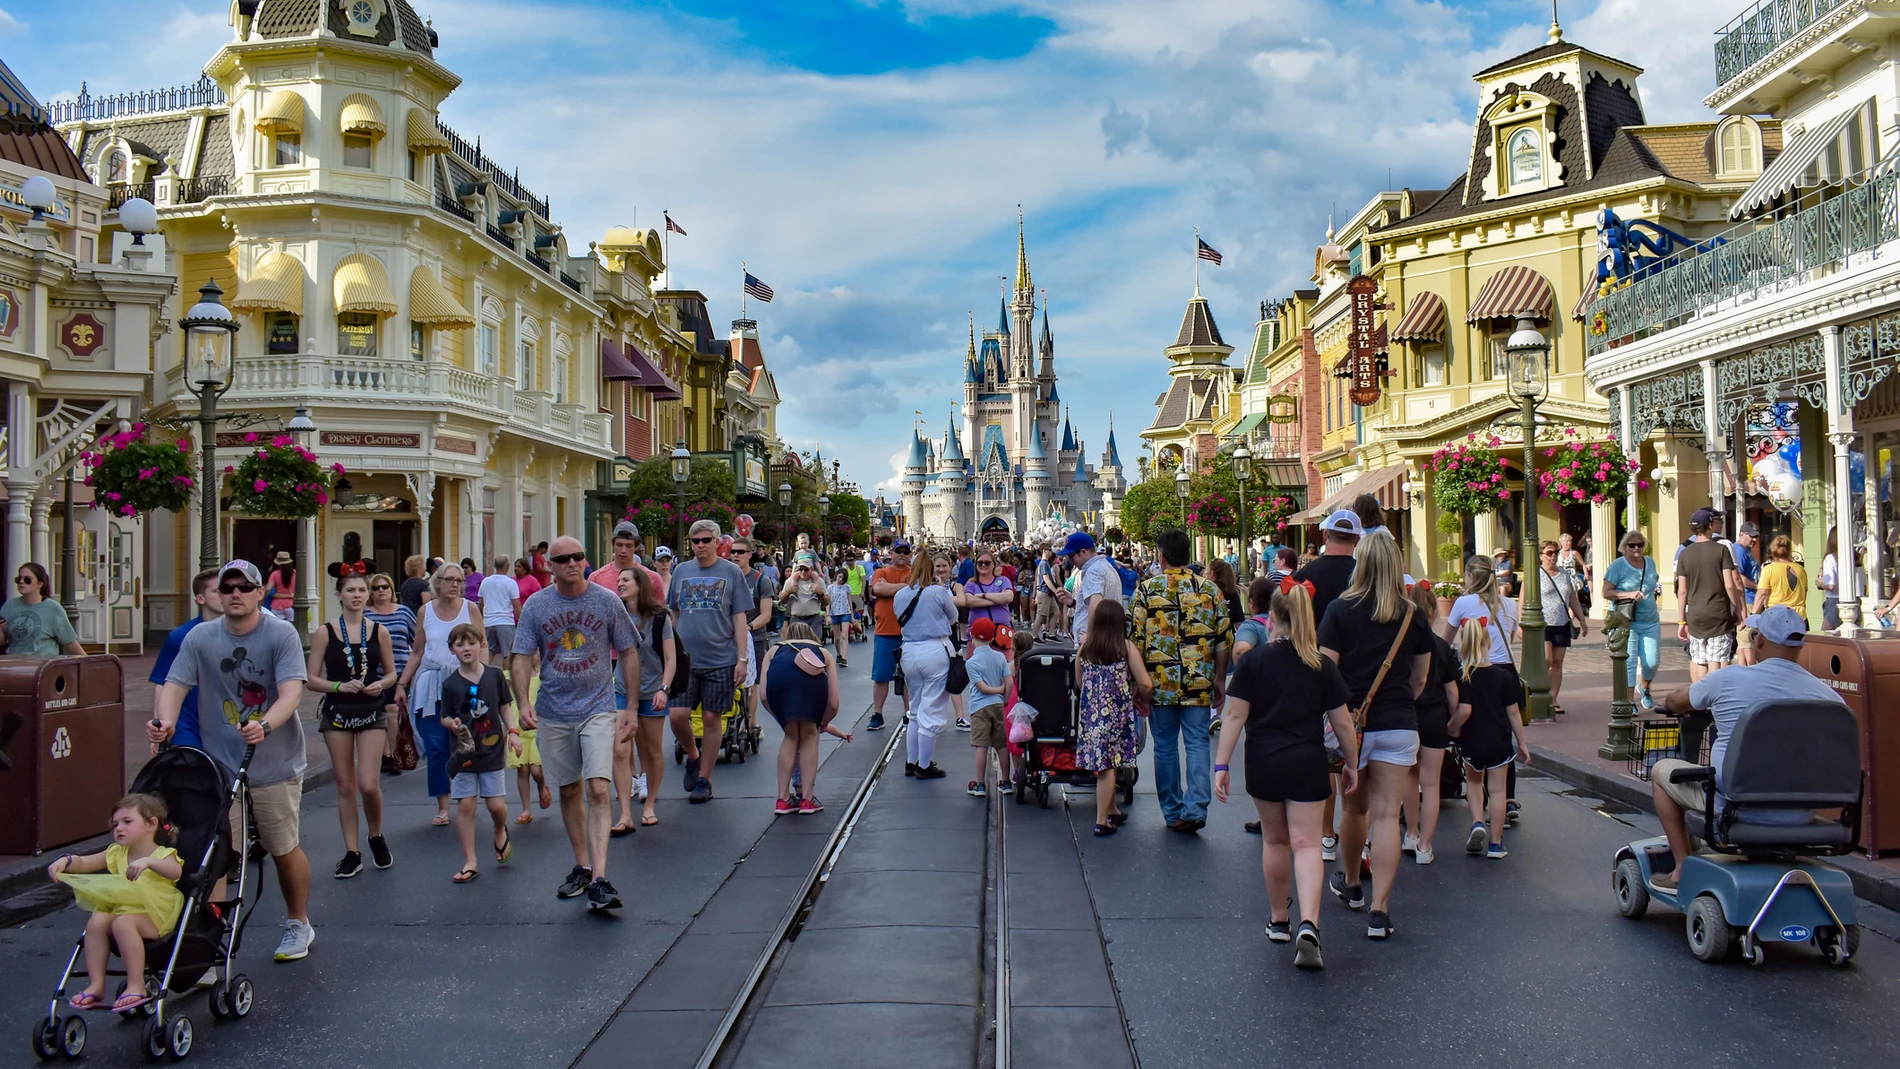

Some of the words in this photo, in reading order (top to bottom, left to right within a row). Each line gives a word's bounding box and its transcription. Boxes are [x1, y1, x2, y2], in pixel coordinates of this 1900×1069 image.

[1357, 293, 1370, 348] CRYSTAL
[1359, 356, 1371, 388] ARTS
[541, 610, 603, 636] CHICAGO
